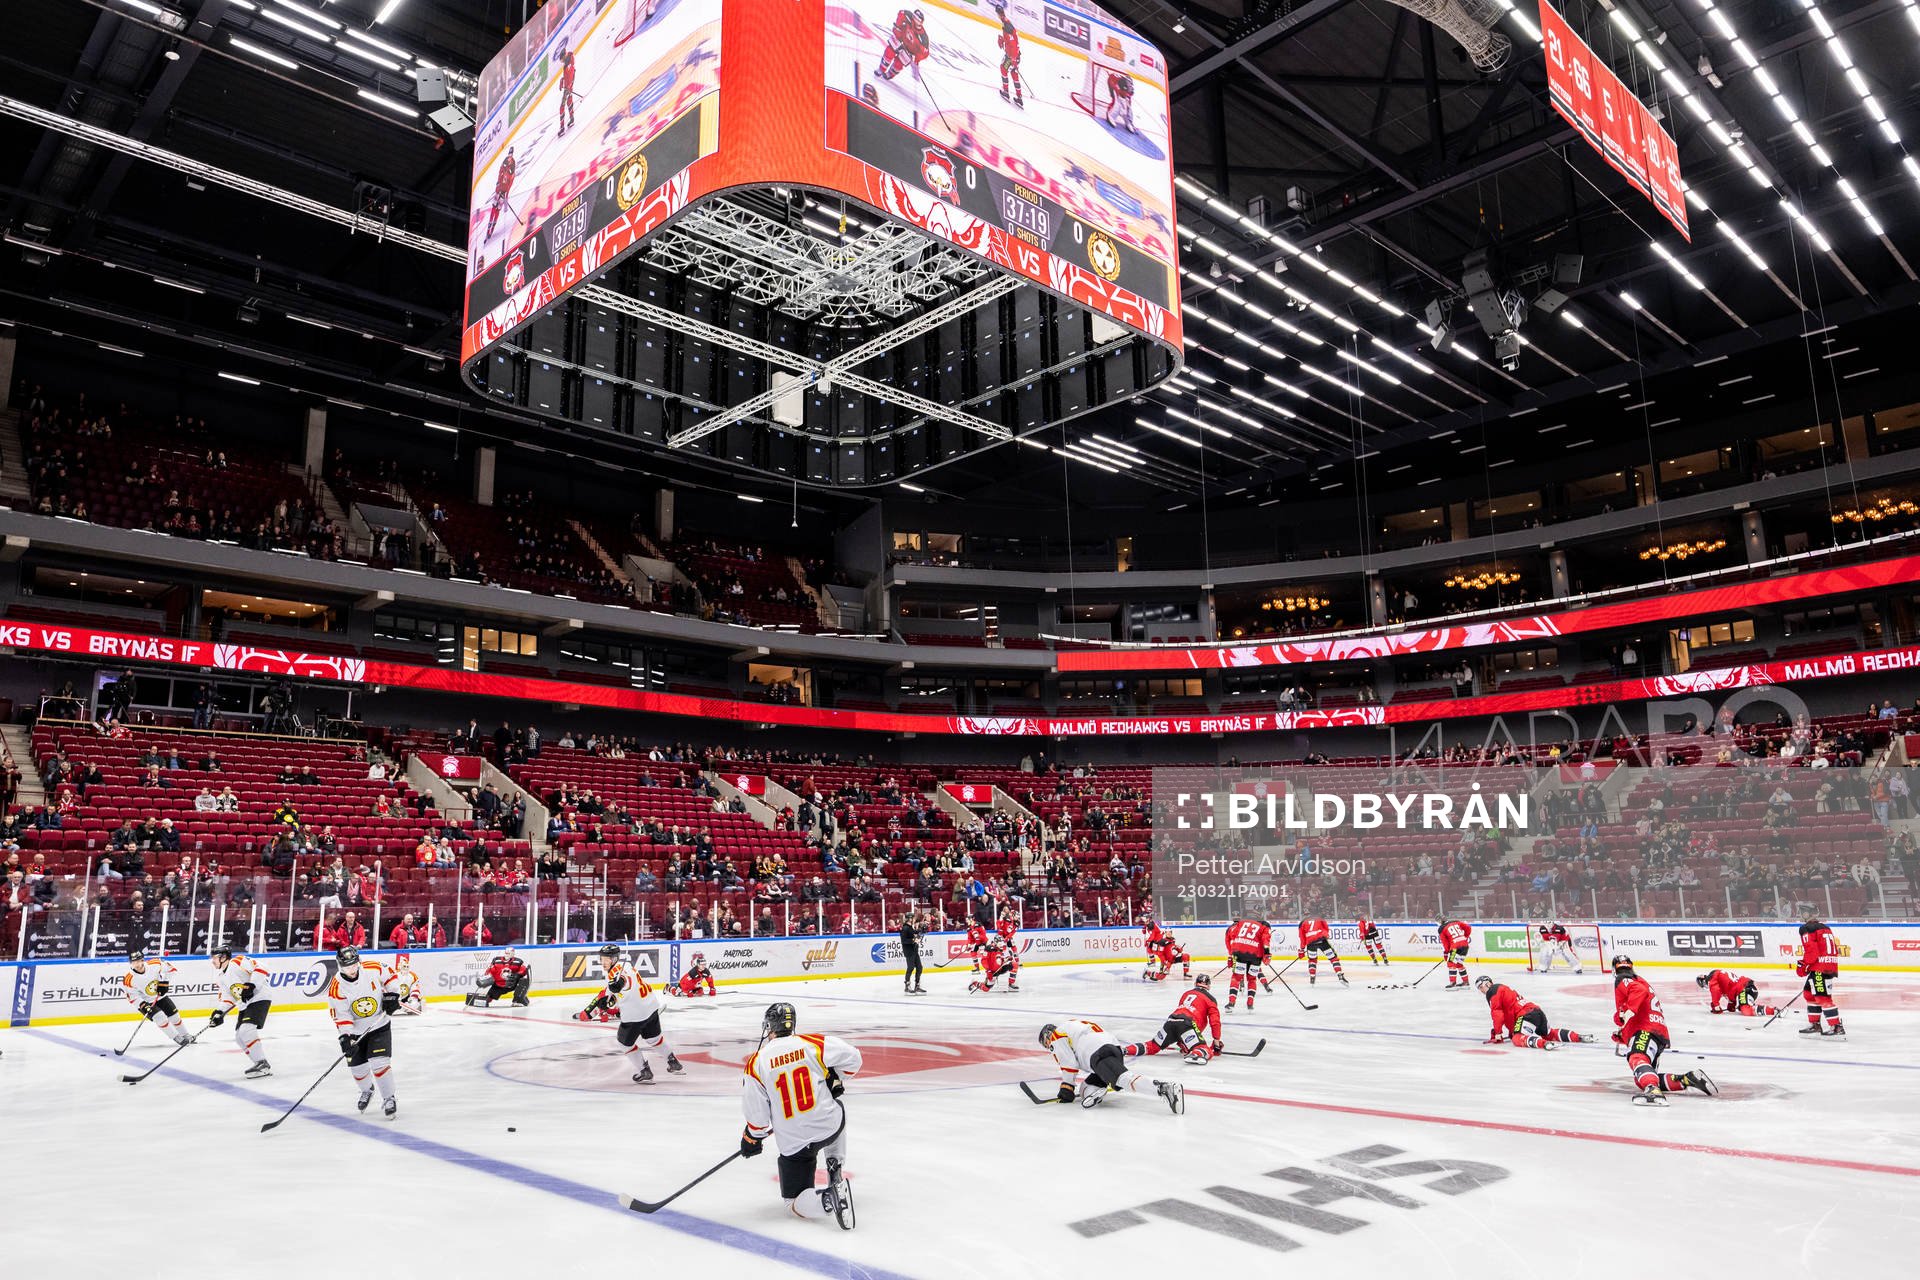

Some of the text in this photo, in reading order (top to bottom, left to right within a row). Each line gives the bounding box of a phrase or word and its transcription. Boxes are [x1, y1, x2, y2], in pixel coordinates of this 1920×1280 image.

[1548, 28, 1565, 71] 21
[1573, 56, 1592, 100] 66
[1602, 87, 1614, 122] 5
[1628, 114, 1636, 145] 1
[606, 175, 614, 200] 0
[965, 164, 976, 189] 0
[1014, 183, 1038, 205] PERIOD
[562, 198, 580, 218] PERIOD
[1006, 196, 1047, 235] 37:19
[554, 208, 585, 248] 37:19
[1008, 223, 1047, 251] 0 SHOTS 0
[1073, 221, 1083, 244] 0
[529, 237, 537, 260] 0
[560, 240, 577, 260] SHOTS
[1018, 245, 1041, 276] VS
[559, 259, 576, 287] VS
[41, 629, 72, 650] VS
[89, 635, 174, 661] BRYNÄS
[181, 645, 200, 662] IF
[1784, 655, 1856, 680] MALMÖ
[1050, 716, 1268, 735] MALMÖ REDHAWKS VS BRYNÄS IF
[1238, 922, 1260, 939] 63
[1308, 921, 1315, 931] 7
[806, 941, 839, 962] guld
[1036, 937, 1071, 948] Climat80
[1084, 935, 1142, 951] navigato
[1497, 935, 1536, 949] Lendo
[1673, 934, 1756, 949] GUIDE
[709, 960, 768, 970] HÄLSOSAM UNGDOM
[723, 949, 753, 958] PARTNERS
[17, 967, 30, 1015] CCM
[370, 981, 377, 991] A
[770, 1048, 806, 1069] LARSSON
[775, 1065, 817, 1120] 10
